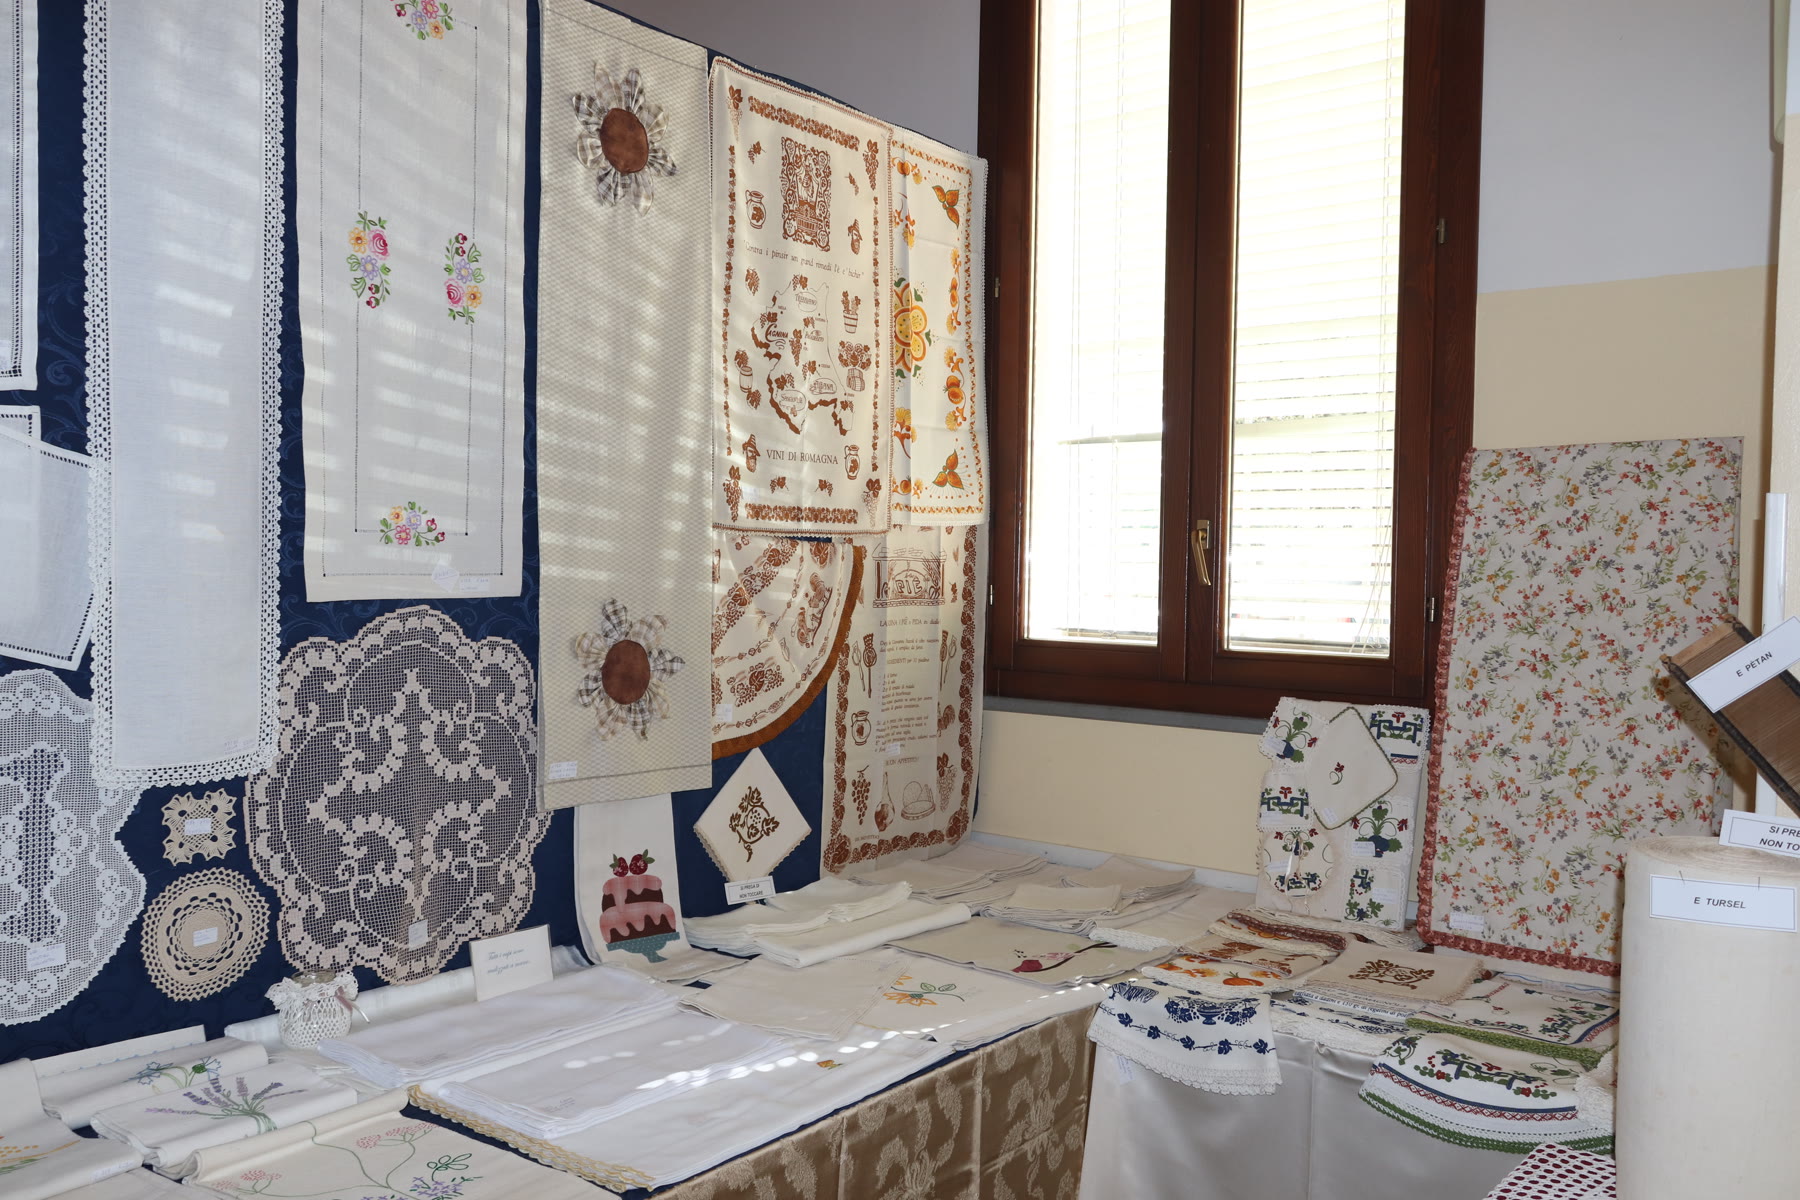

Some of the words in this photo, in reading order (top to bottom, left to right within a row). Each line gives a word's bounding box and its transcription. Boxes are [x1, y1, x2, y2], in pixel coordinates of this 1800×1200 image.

[766, 449, 785, 460] VINI
[788, 451, 797, 461] DI
[800, 452, 839, 465] ROMAGNA
[1736, 669, 1744, 677] E
[1769, 825, 1780, 834] SI
[1759, 838, 1783, 848] NON
[1693, 896, 1701, 905] E
[1706, 897, 1746, 909] TURSEL
